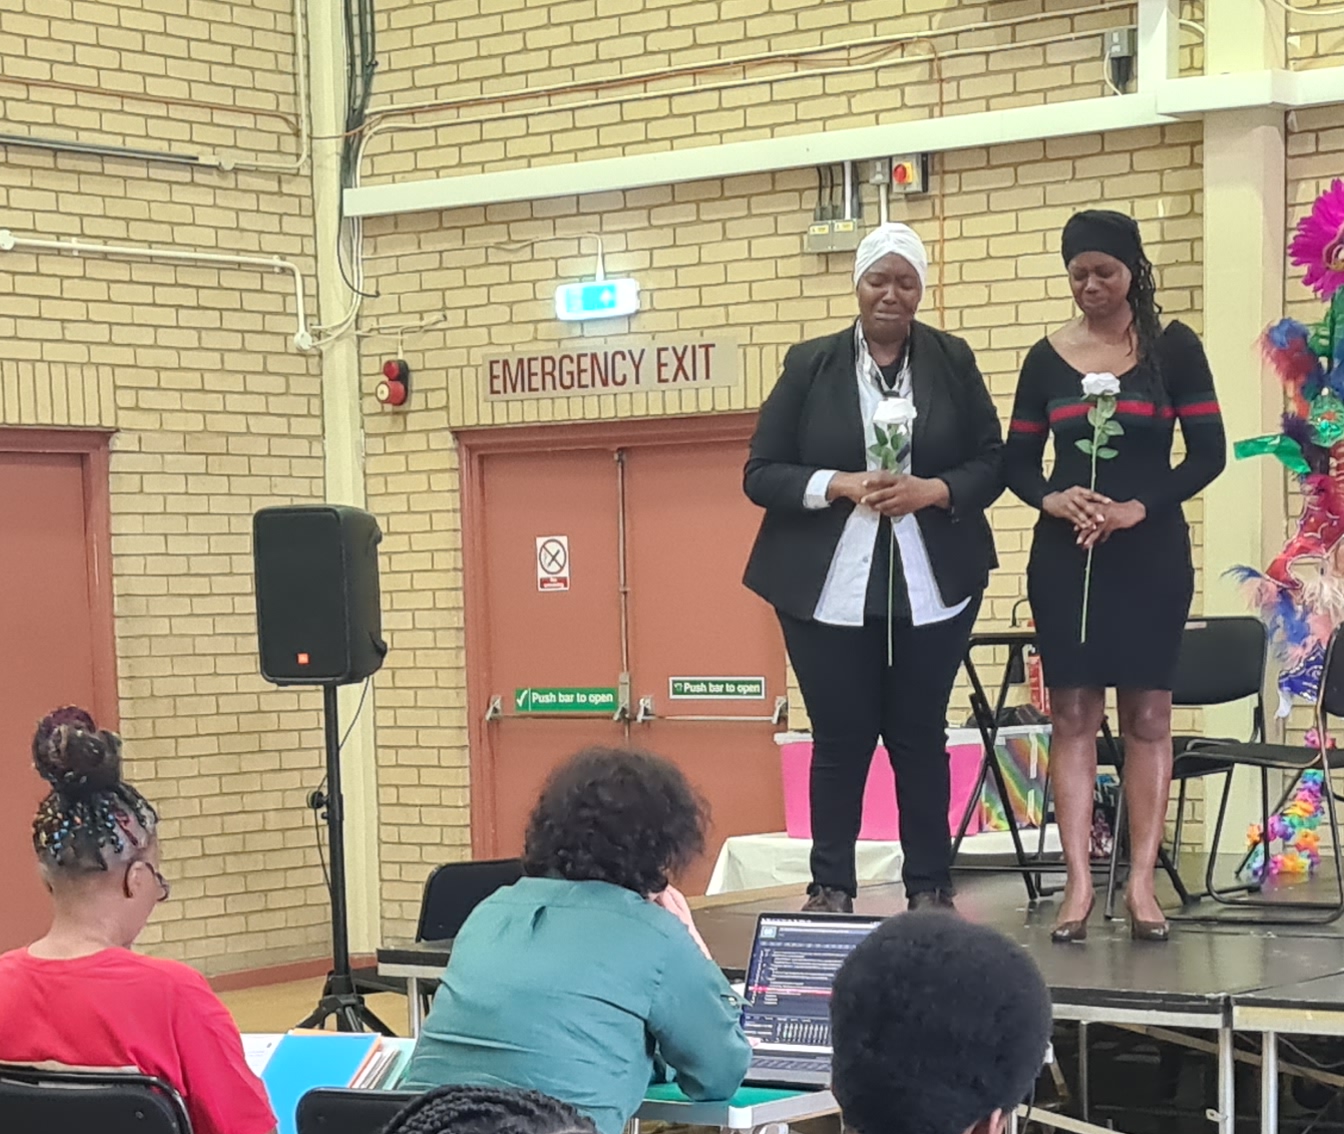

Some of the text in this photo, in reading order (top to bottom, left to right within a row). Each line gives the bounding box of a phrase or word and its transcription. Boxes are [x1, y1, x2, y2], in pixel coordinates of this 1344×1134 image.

[488, 343, 716, 395] EMERGENCY EXIT
[683, 682, 760, 695] Push bar to open
[531, 691, 613, 705] Push bar to open
